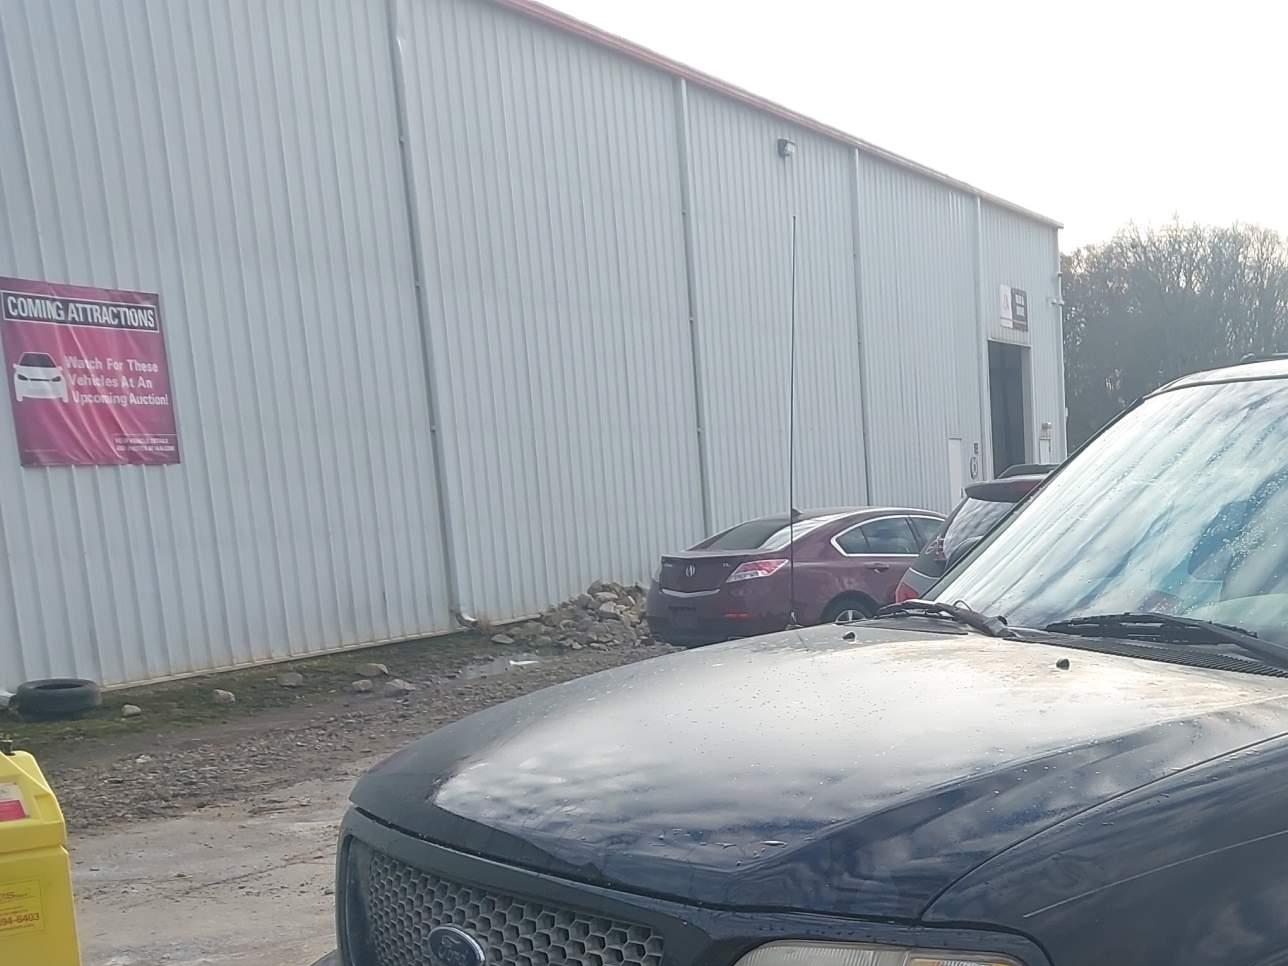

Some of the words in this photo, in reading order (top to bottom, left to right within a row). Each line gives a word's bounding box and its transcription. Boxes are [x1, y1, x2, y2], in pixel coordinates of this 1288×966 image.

[7, 296, 65, 321] COMING
[68, 303, 155, 328] ATTRACTIONS
[64, 356, 103, 370] Watch
[106, 358, 123, 371] For
[127, 359, 159, 373] These
[69, 373, 119, 388] Vehicles
[121, 375, 136, 388] At
[138, 376, 153, 388] An
[72, 390, 127, 407] Upcoming
[129, 393, 169, 406] Auction!
[438, 935, 468, 966] Ford
